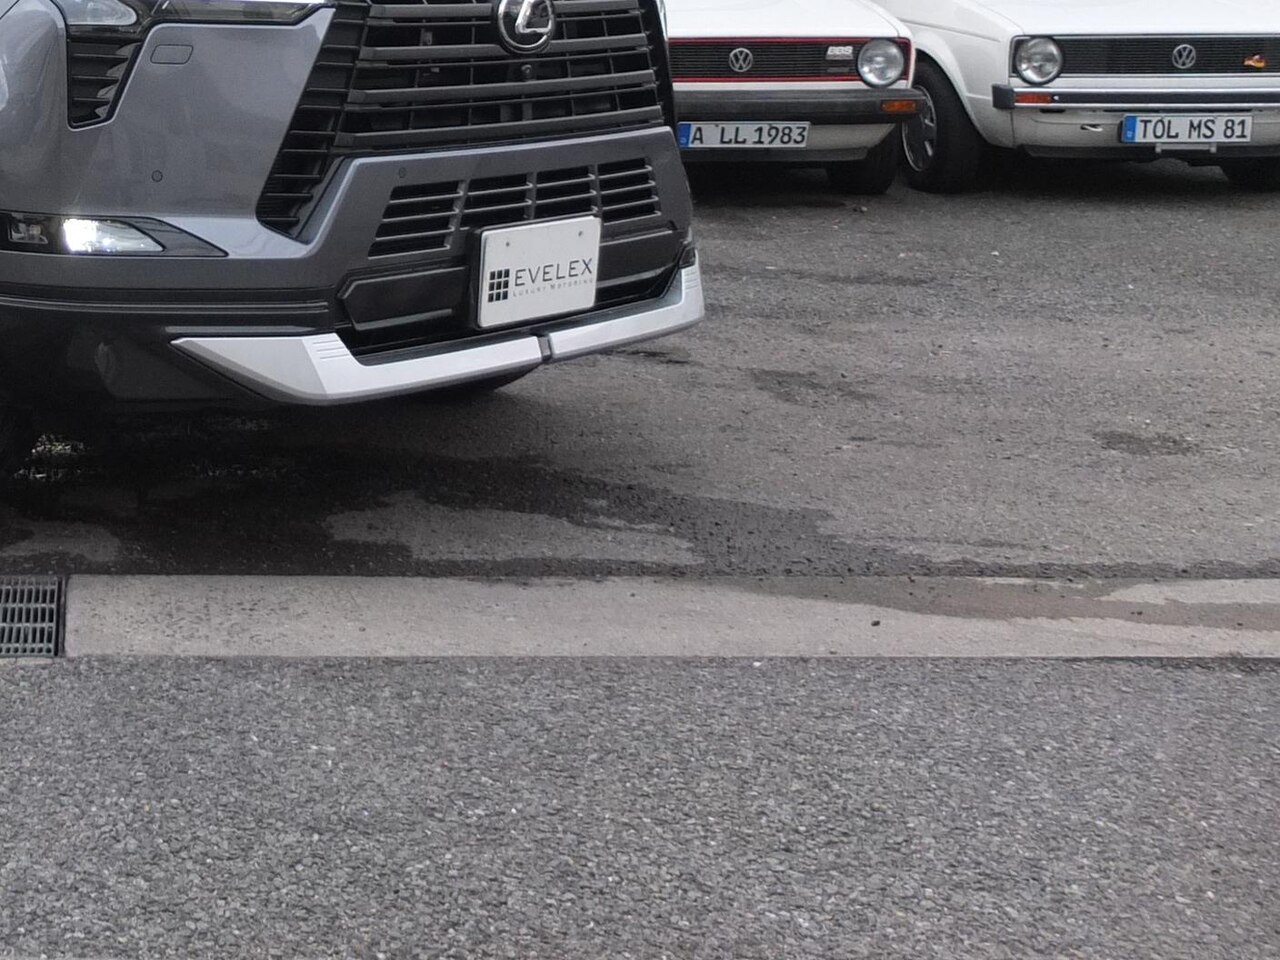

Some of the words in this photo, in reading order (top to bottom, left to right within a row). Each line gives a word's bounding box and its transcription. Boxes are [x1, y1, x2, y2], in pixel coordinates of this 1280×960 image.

[691, 126, 704, 145] A
[719, 126, 747, 145] LL
[752, 125, 807, 145] 1983
[1188, 119, 1216, 139] MS
[1223, 118, 1248, 139] 81
[514, 257, 593, 287] EVELEX
